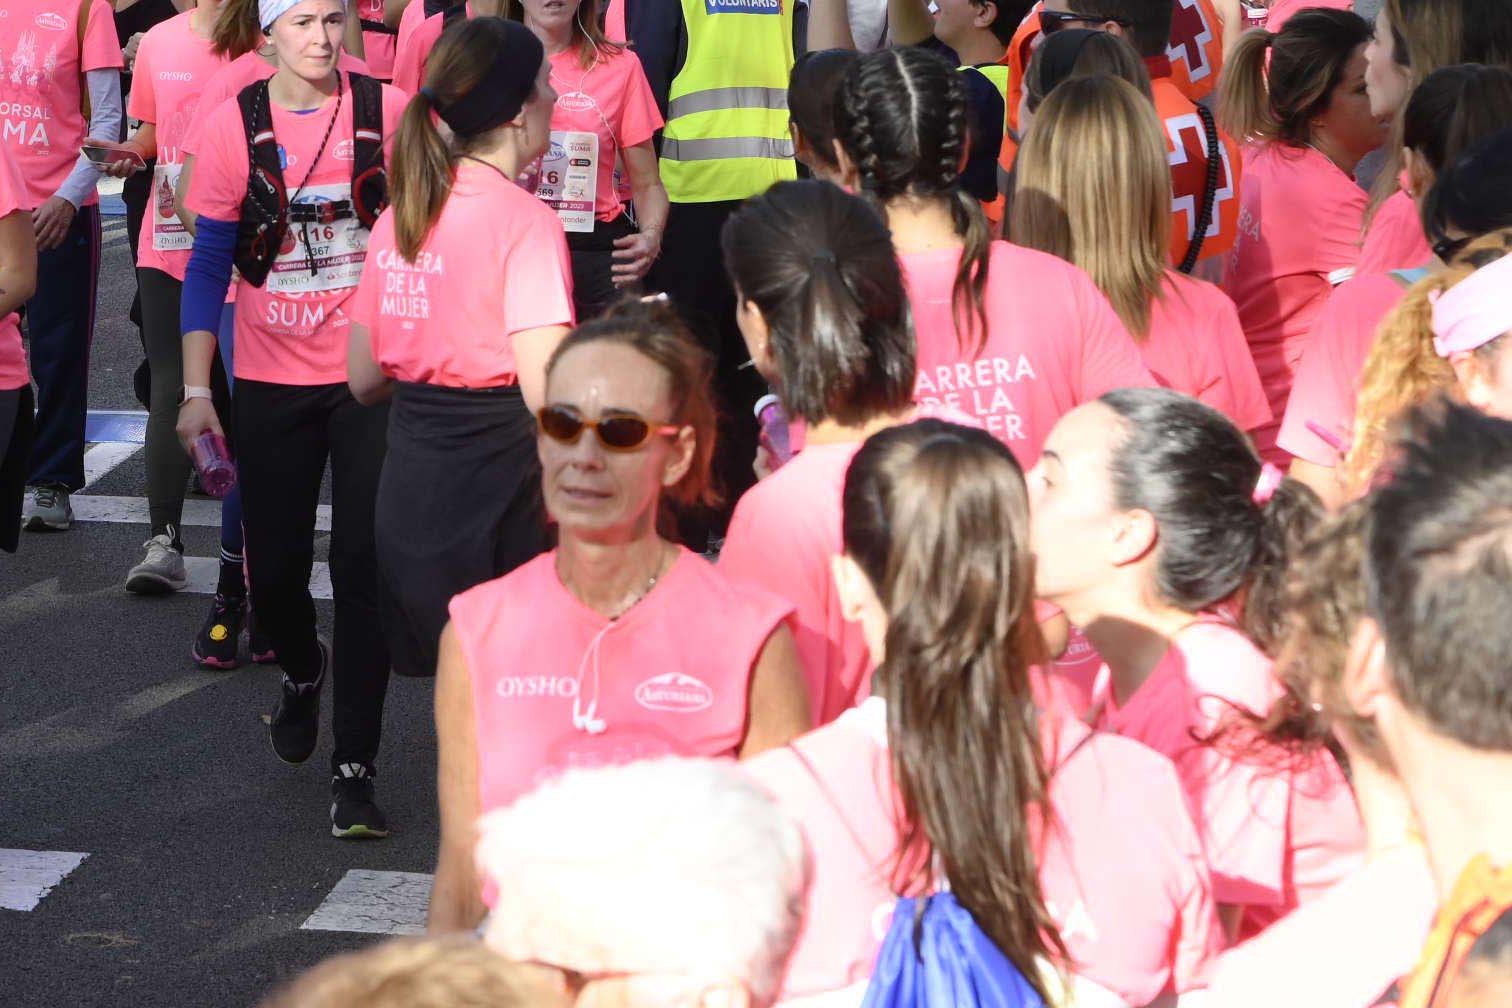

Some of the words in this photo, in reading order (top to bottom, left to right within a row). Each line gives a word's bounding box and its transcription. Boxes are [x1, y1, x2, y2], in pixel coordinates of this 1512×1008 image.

[561, 215, 586, 224] ntander
[310, 245, 330, 256] 367
[277, 263, 306, 271] CARRERA
[386, 271, 405, 293] DE
[409, 273, 426, 297] LA
[381, 295, 429, 319] MUJER
[915, 353, 1036, 396] ARRERA
[974, 387, 1014, 415] LA
[496, 675, 579, 698] OYSHO
